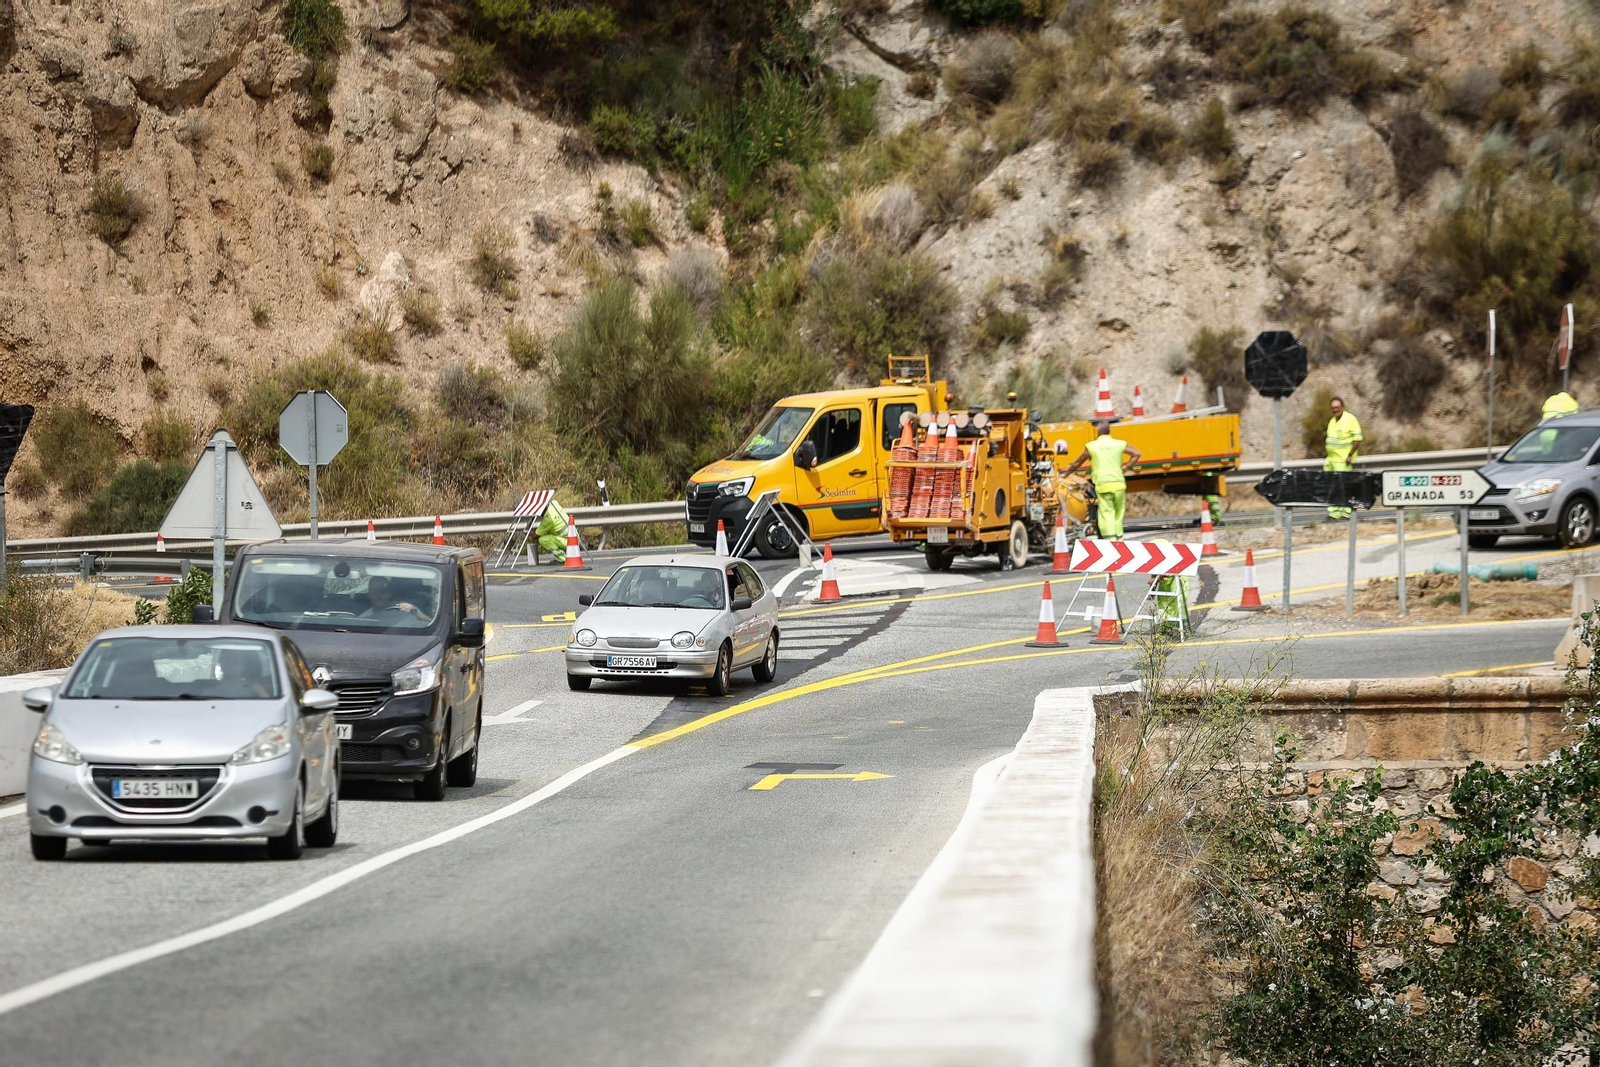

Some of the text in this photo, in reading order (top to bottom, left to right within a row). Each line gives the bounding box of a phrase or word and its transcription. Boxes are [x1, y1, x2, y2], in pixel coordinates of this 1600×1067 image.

[1400, 476, 1461, 485] E-902 N-323
[1387, 491, 1474, 500] GRANADA 53
[123, 782, 193, 796] 5435 HNW
